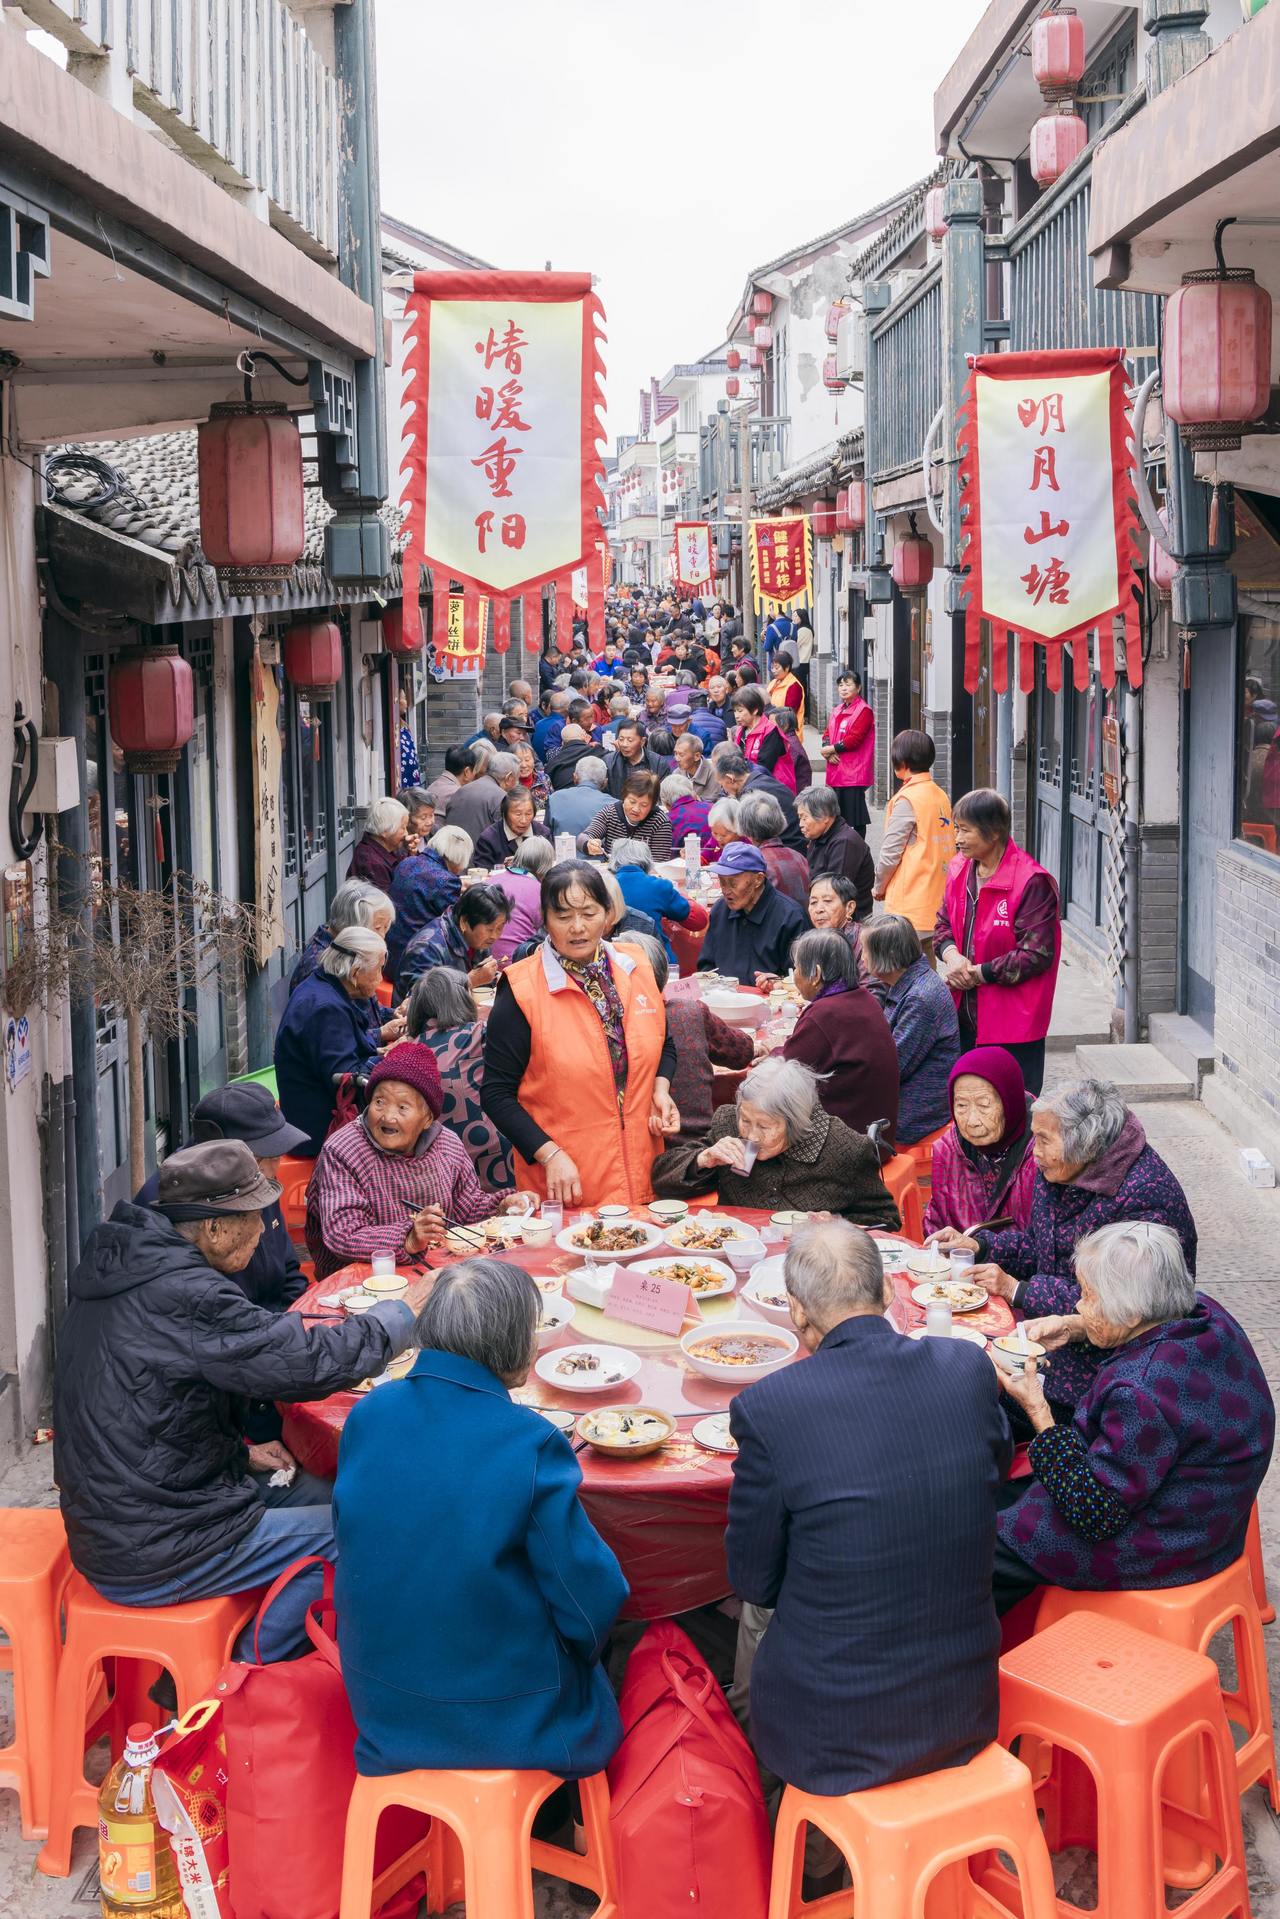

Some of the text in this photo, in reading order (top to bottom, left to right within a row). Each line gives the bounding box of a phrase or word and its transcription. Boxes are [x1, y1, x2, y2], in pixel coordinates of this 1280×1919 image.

[471, 319, 532, 554] 情暖重阳
[1017, 392, 1070, 606] 明月山塘
[687, 532, 700, 579] 情暖重阳
[448, 600, 460, 651] 萝卜丝饼
[650, 1283, 661, 1294] 25
